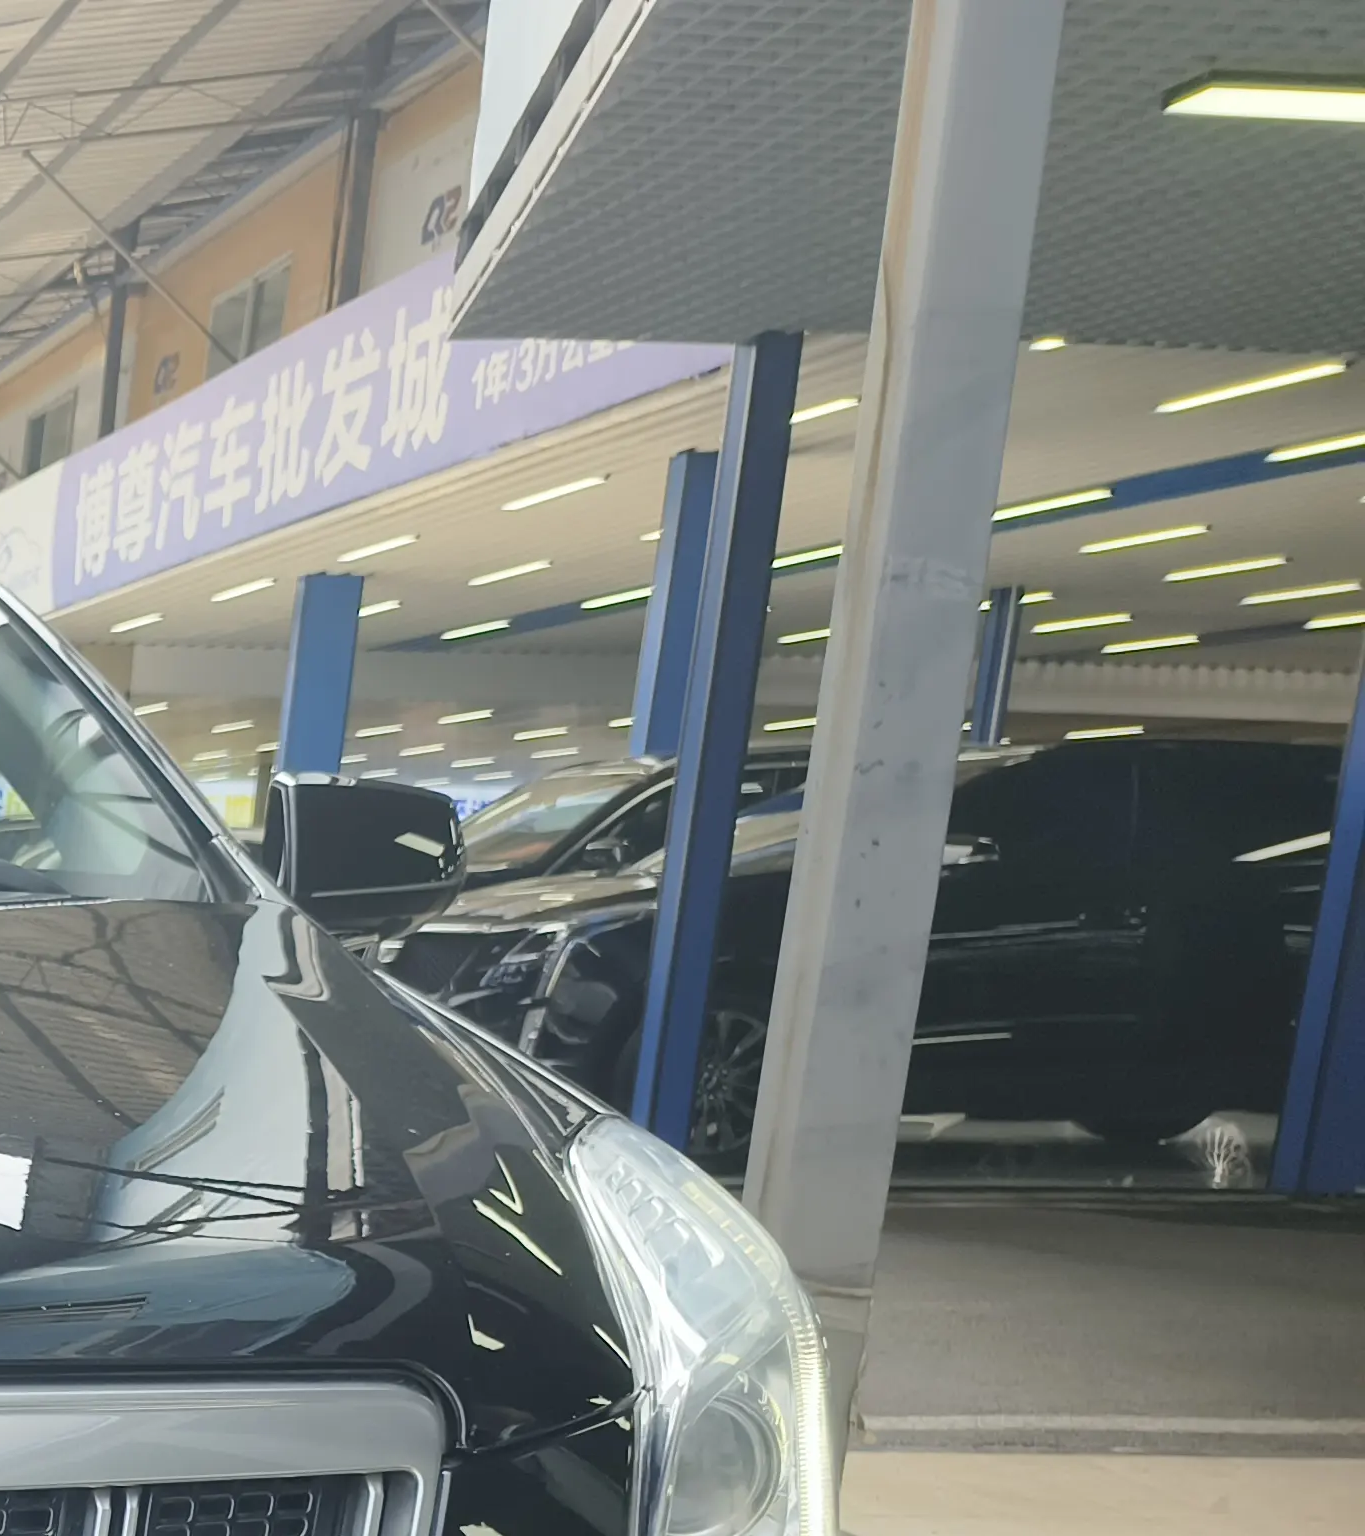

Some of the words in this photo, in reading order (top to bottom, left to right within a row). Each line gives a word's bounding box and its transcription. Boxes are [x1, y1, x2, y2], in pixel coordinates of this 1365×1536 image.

[73, 286, 451, 586] 博尊汽车批发城
